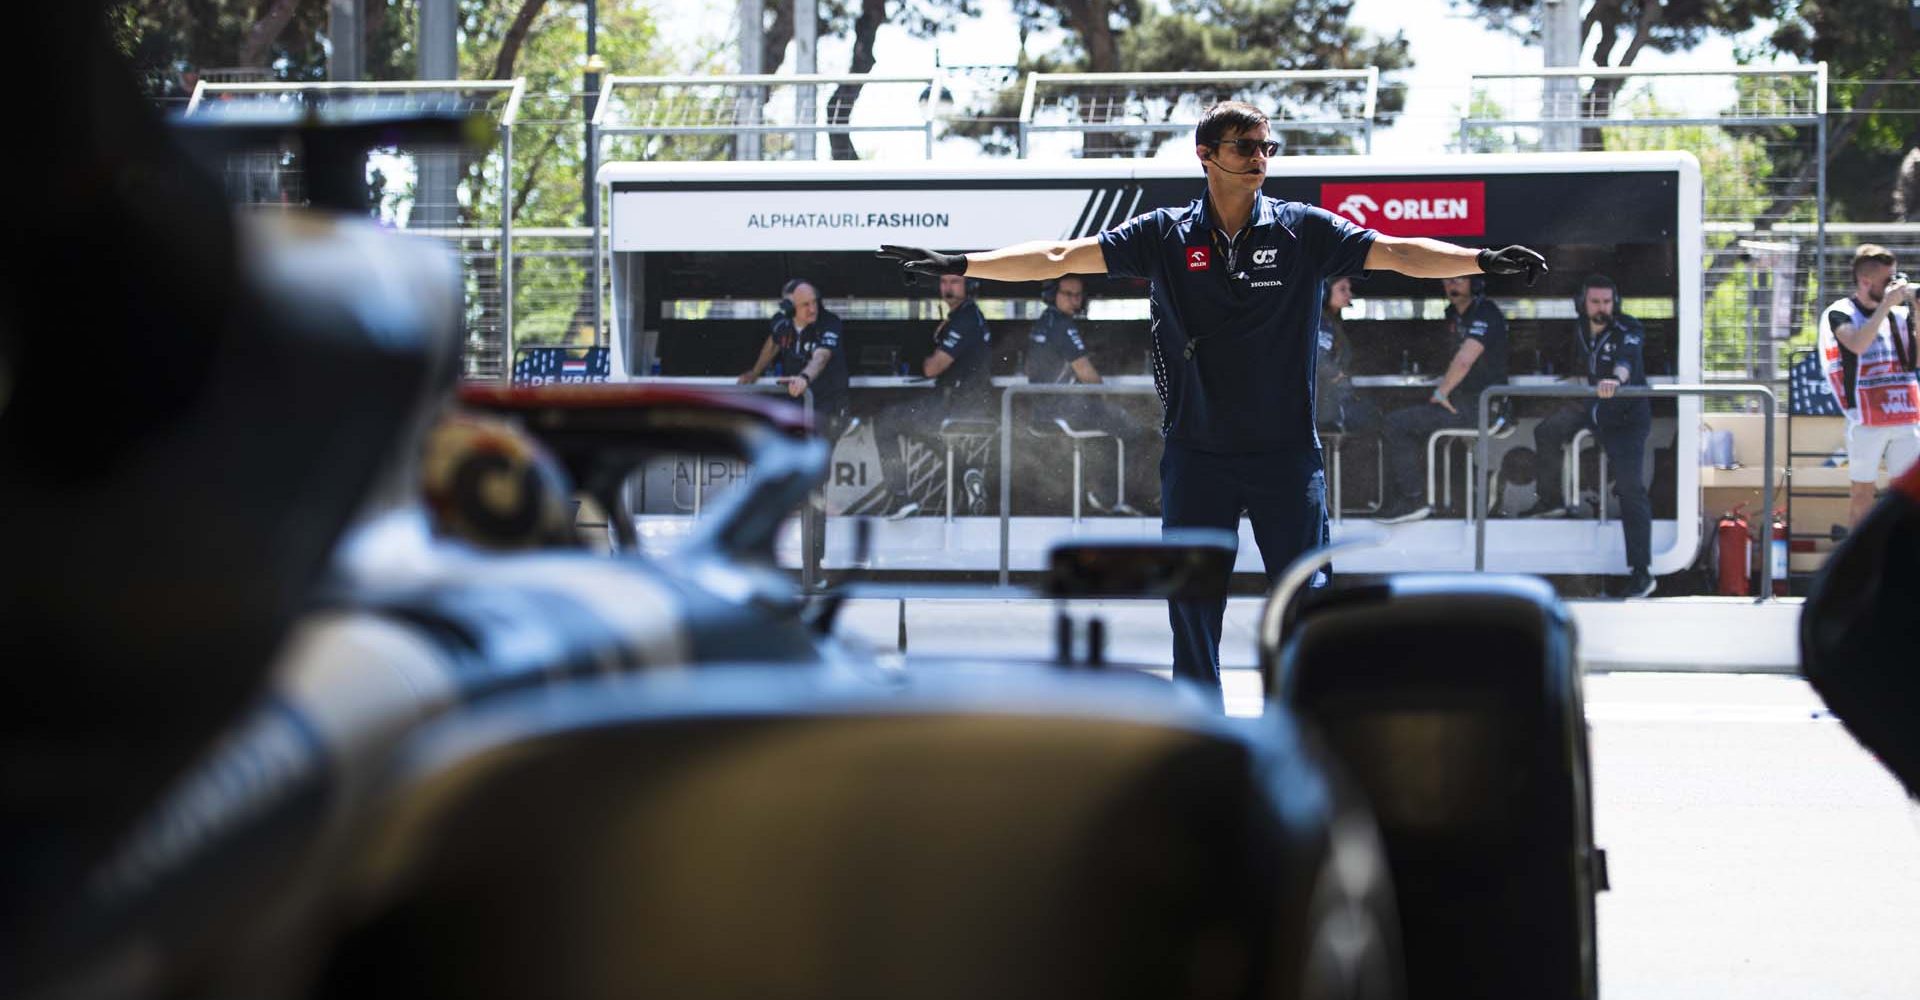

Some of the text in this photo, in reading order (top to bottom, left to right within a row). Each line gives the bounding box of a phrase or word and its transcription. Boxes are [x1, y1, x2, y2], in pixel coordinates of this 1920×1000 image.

[1383, 198, 1468, 220] ORLEN
[747, 213, 949, 228] ALPHATAURI.FASHION
[1250, 280, 1283, 288] HONDA
